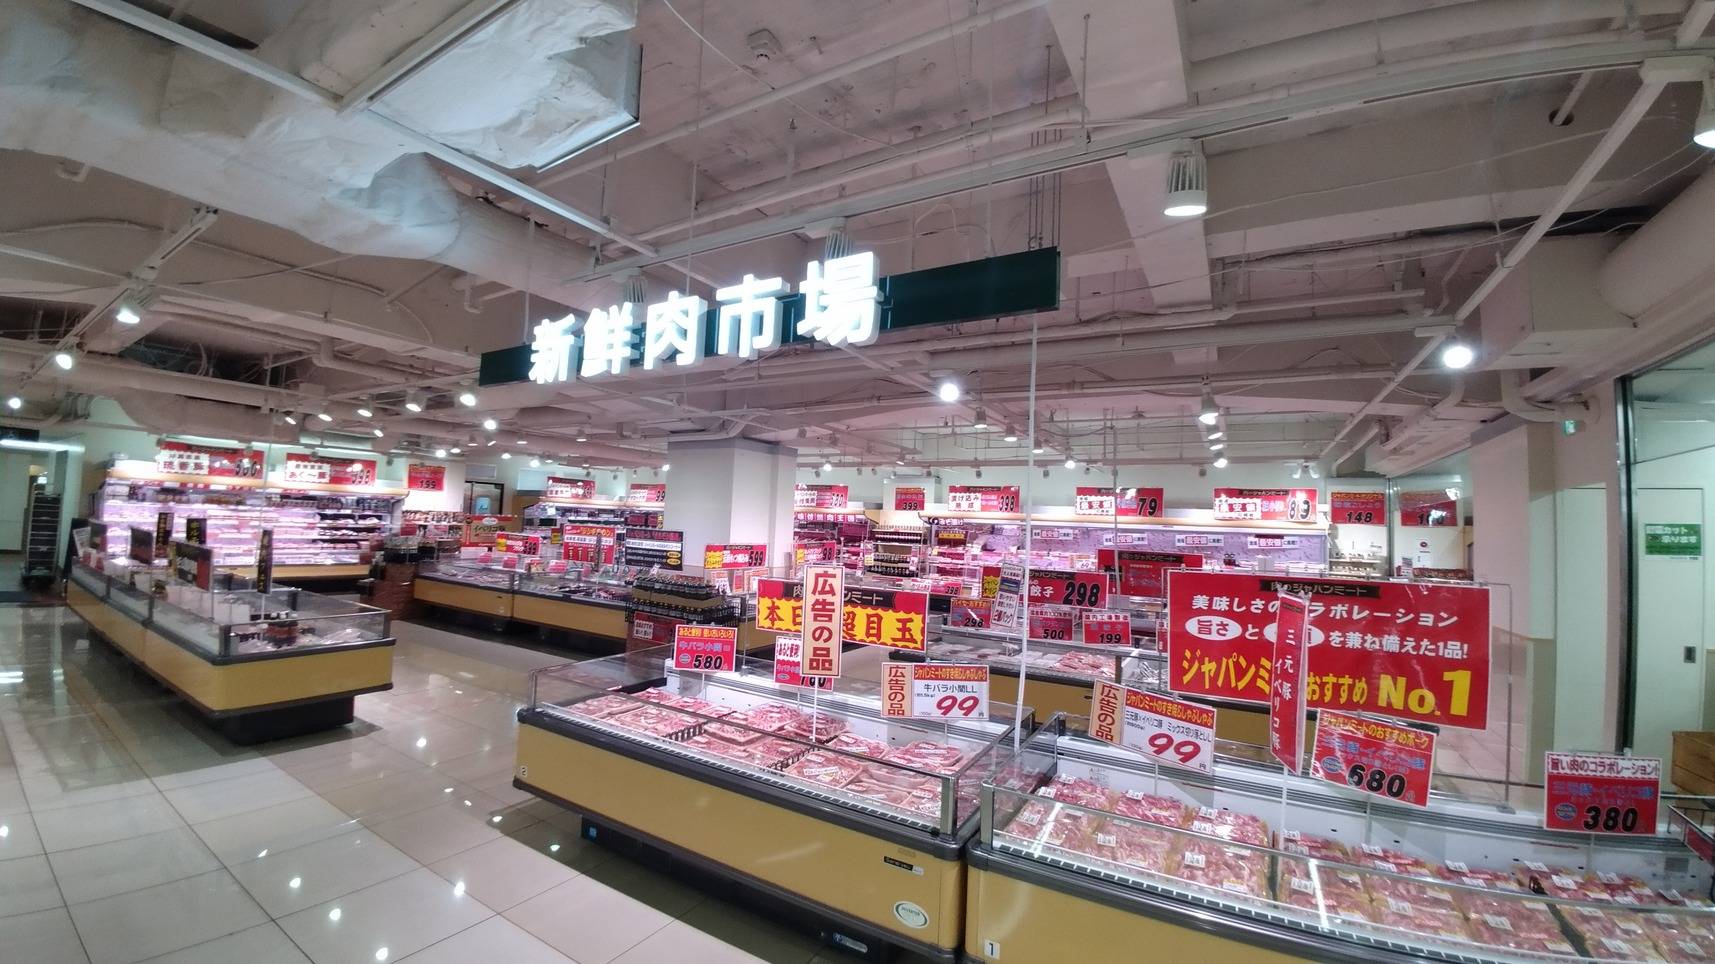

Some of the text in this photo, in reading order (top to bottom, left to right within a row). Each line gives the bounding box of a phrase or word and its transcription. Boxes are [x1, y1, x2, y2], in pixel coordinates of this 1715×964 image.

[528, 251, 883, 385] 新鮮肉市場
[1138, 497, 1157, 517] 79
[1346, 511, 1373, 523] 148
[748, 550, 764, 567] 599
[1030, 584, 1054, 598] 餃子
[1062, 581, 1101, 608] 298
[764, 600, 919, 645] 本日超目玉
[811, 571, 838, 672] 広告の品
[1192, 594, 1459, 627] 美味しさのラボレーション
[1042, 628, 1065, 640] 500
[1099, 633, 1122, 644] 199
[693, 654, 723, 670] 580
[888, 665, 907, 717] 広告の品
[1378, 669, 1472, 717] No.1
[936, 695, 980, 717] 99
[1095, 683, 1120, 742] 広告の品
[1148, 732, 1202, 764] 99
[1347, 763, 1407, 798] 680
[1583, 804, 1639, 833] 380
